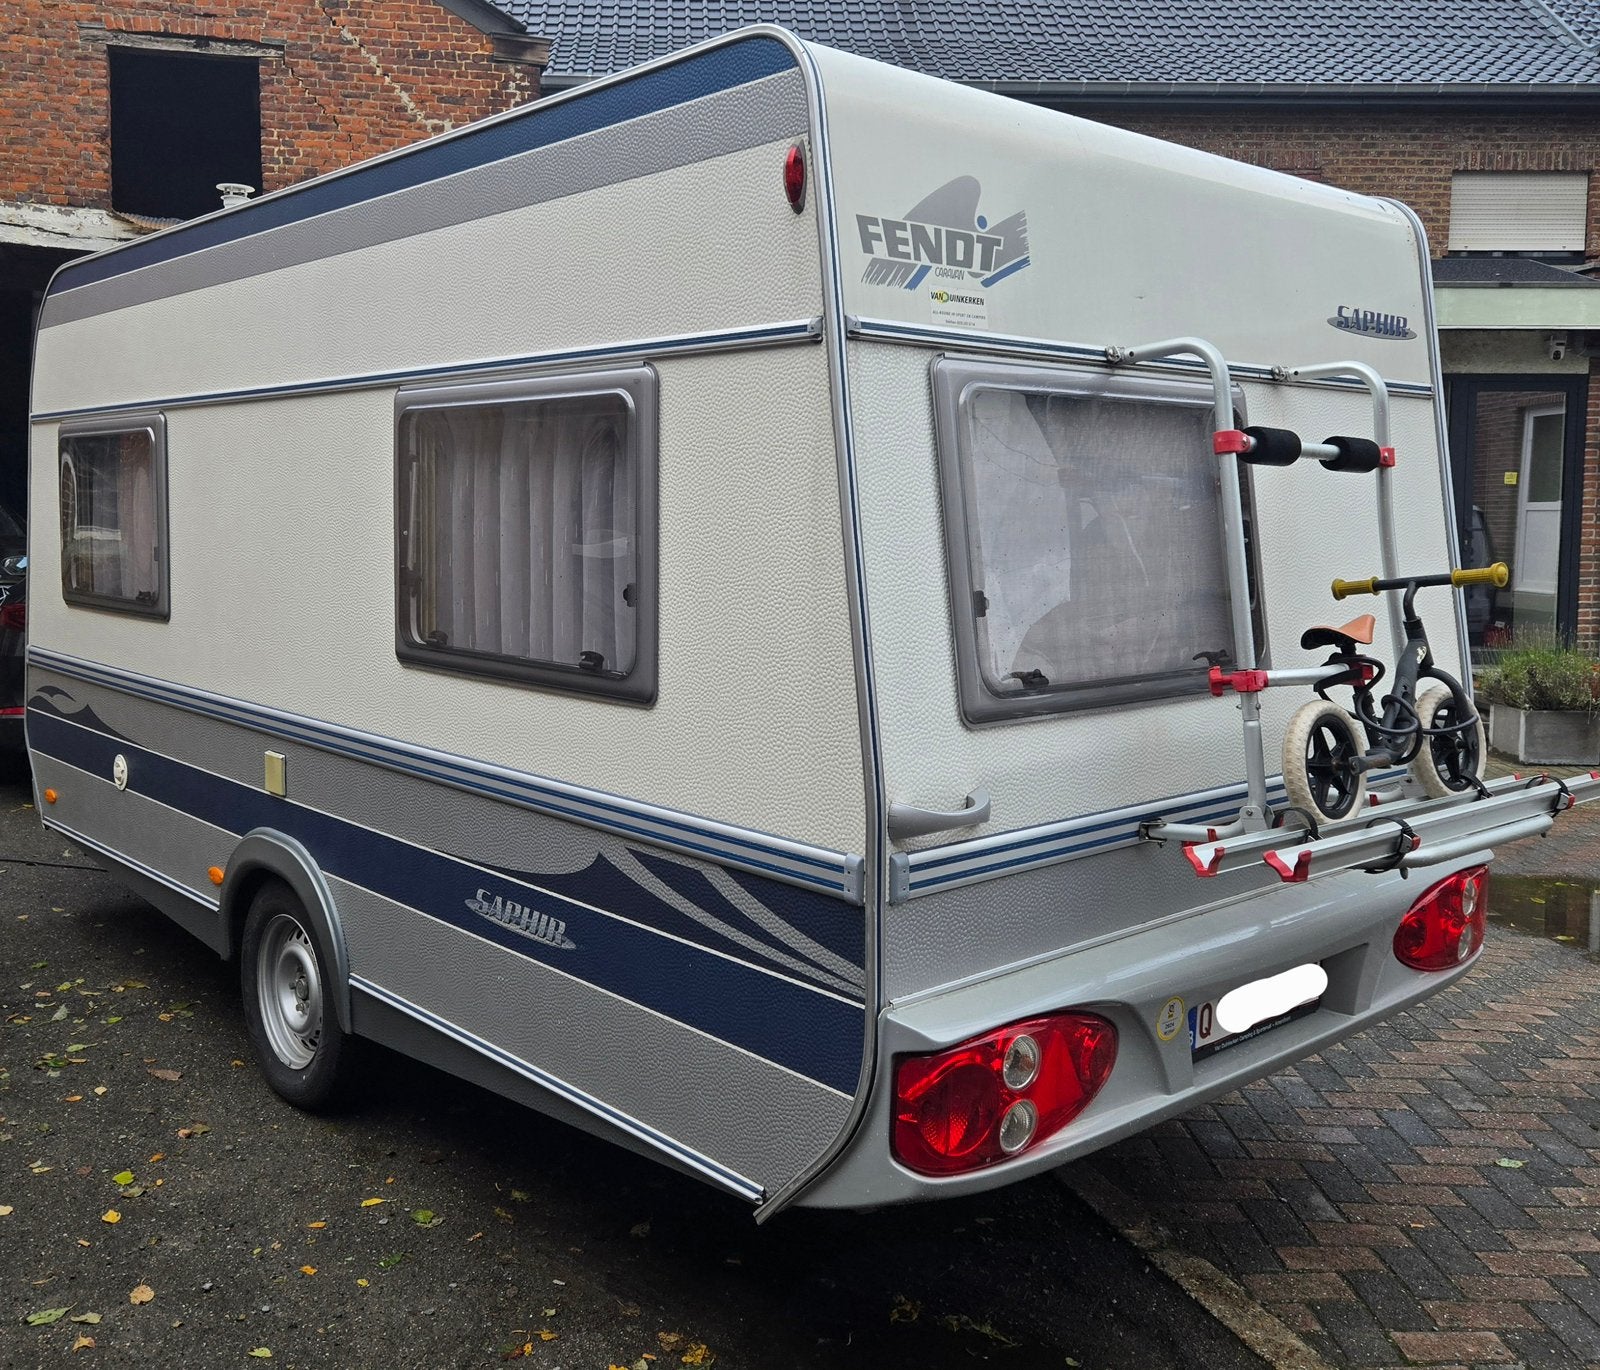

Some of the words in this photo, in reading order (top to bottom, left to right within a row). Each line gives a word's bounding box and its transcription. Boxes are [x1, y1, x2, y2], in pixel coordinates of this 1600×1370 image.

[855, 213, 1003, 272] FENDT
[934, 266, 965, 281] CARAVAN
[1336, 305, 1410, 337] SAPHIR
[474, 888, 566, 945] SAPHIR
[1199, 1003, 1212, 1038] Q
